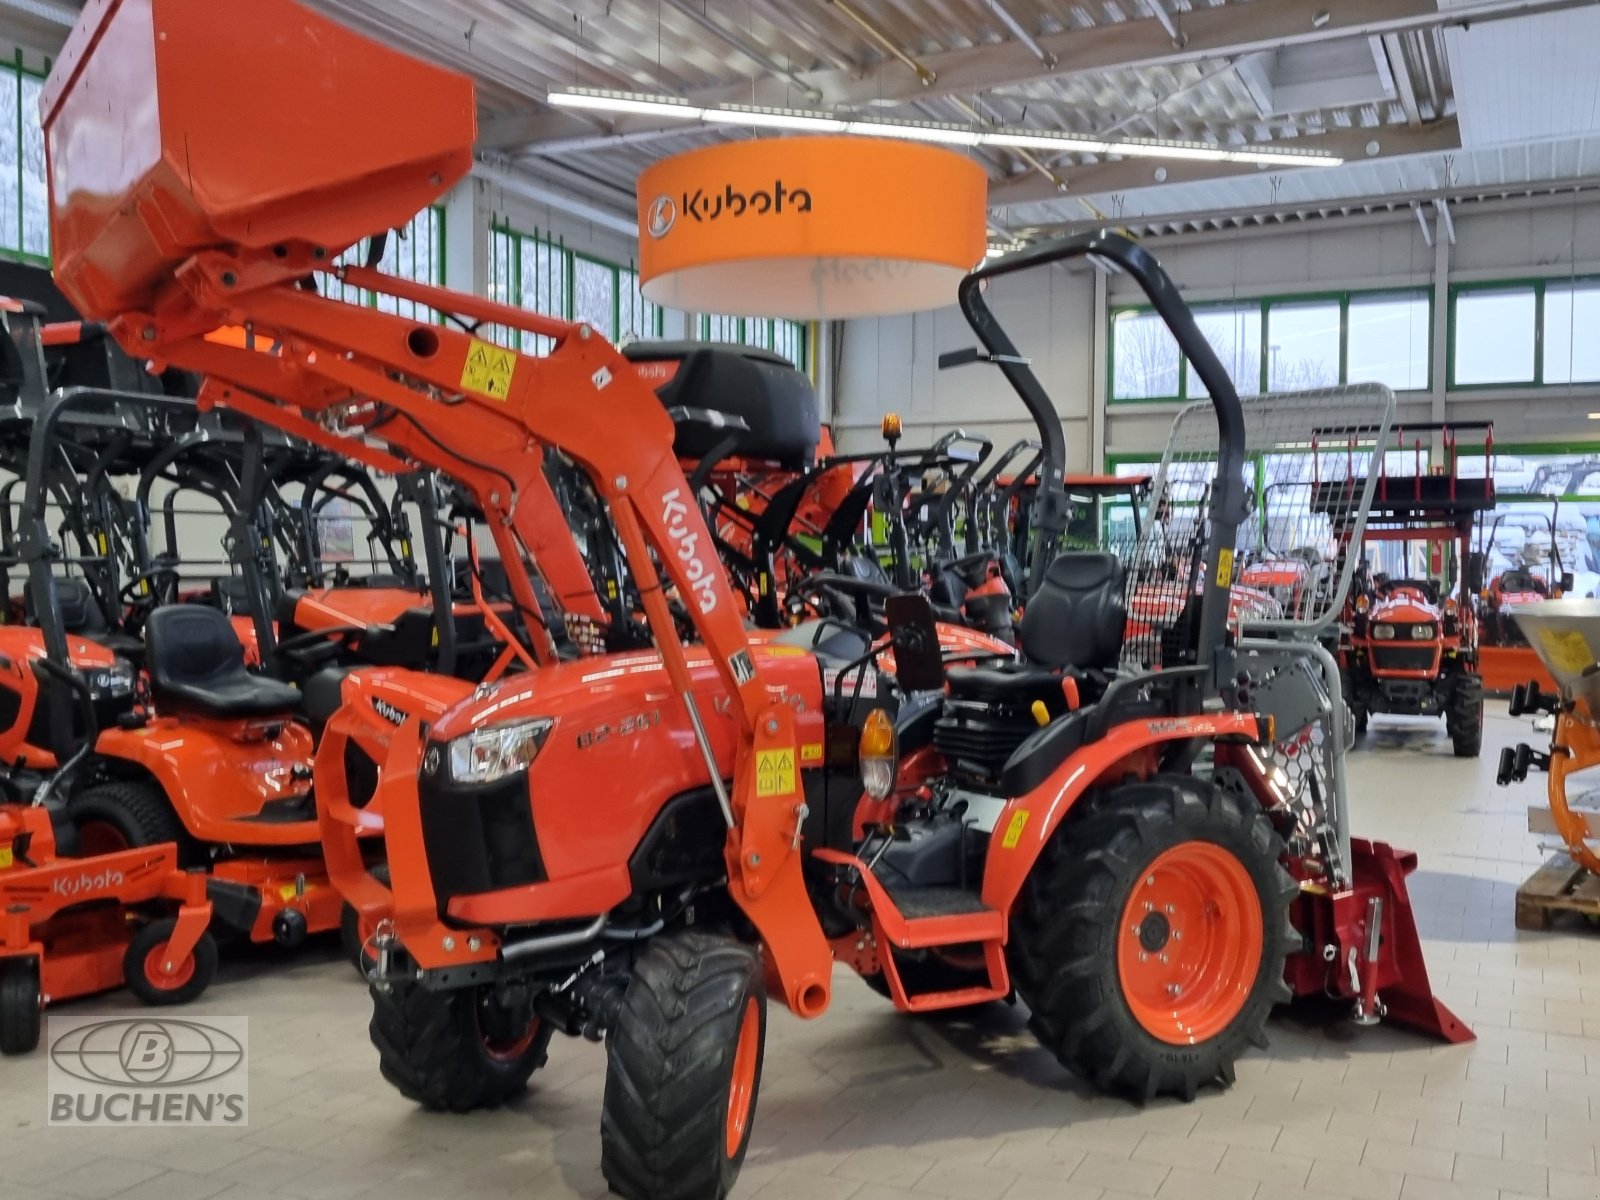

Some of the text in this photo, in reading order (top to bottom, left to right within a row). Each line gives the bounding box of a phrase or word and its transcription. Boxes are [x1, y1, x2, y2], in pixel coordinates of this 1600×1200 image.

[682, 179, 812, 222] Kubota
[661, 487, 717, 615] Kubota
[53, 868, 124, 897] Kubota
